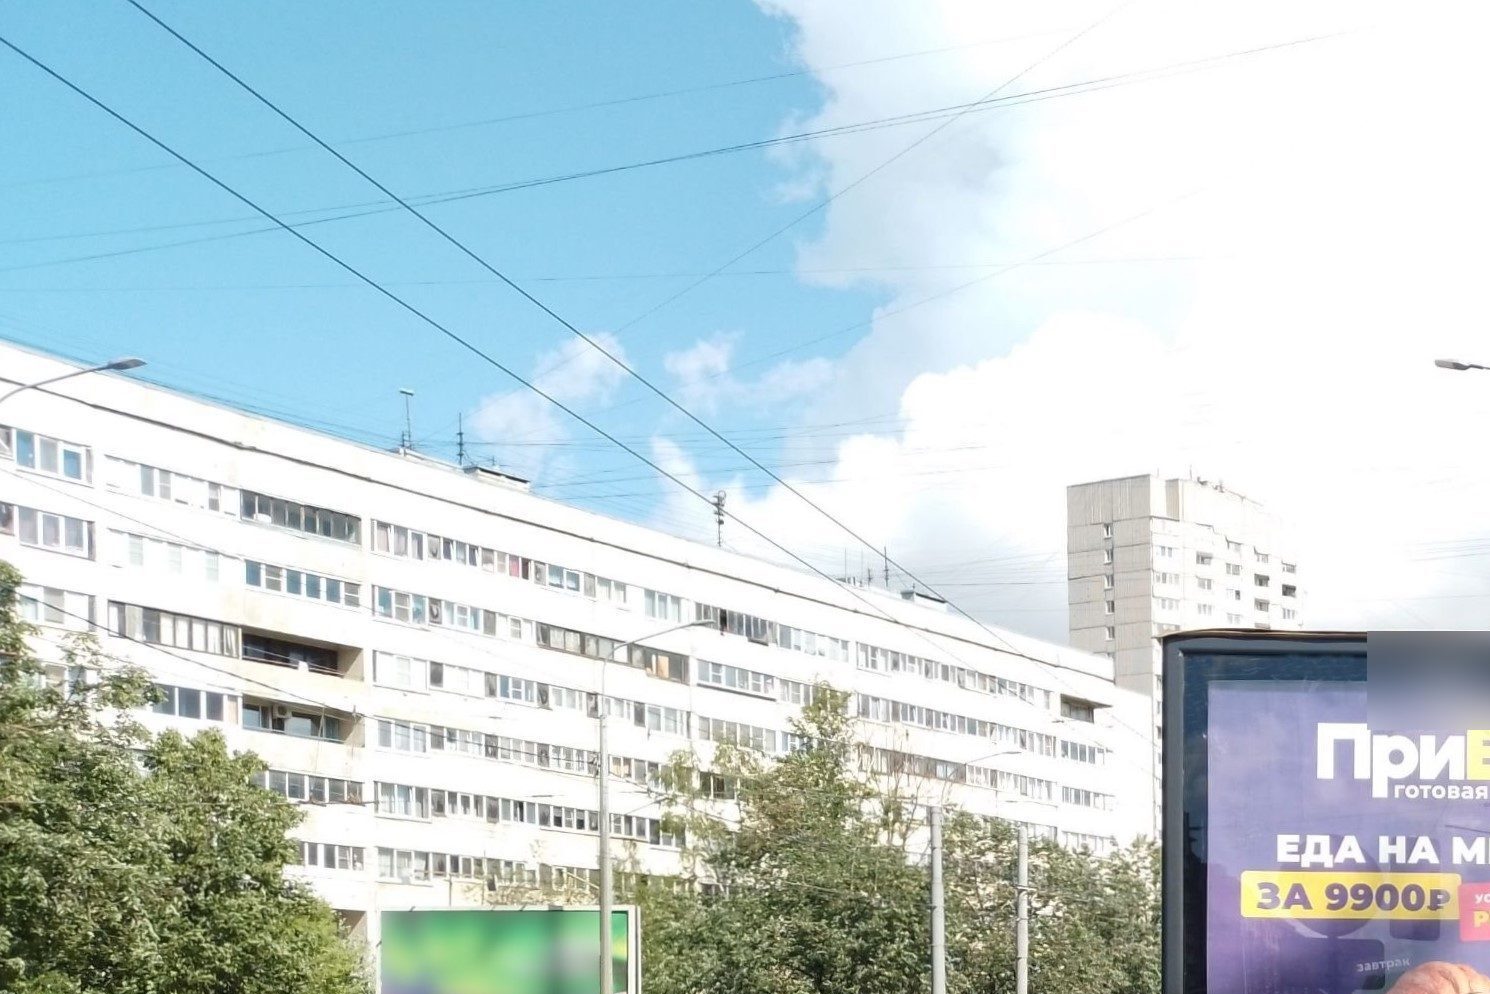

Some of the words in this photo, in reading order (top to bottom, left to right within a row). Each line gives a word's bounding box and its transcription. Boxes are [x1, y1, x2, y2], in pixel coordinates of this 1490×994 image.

[1394, 783, 1488, 799] готовая
[1276, 834, 1365, 868] ЕДА
[1379, 836, 1440, 864] НА
[1257, 882, 1312, 910] ЗА
[1325, 883, 1450, 912] 9900₽
[1356, 958, 1410, 973] завтрак
